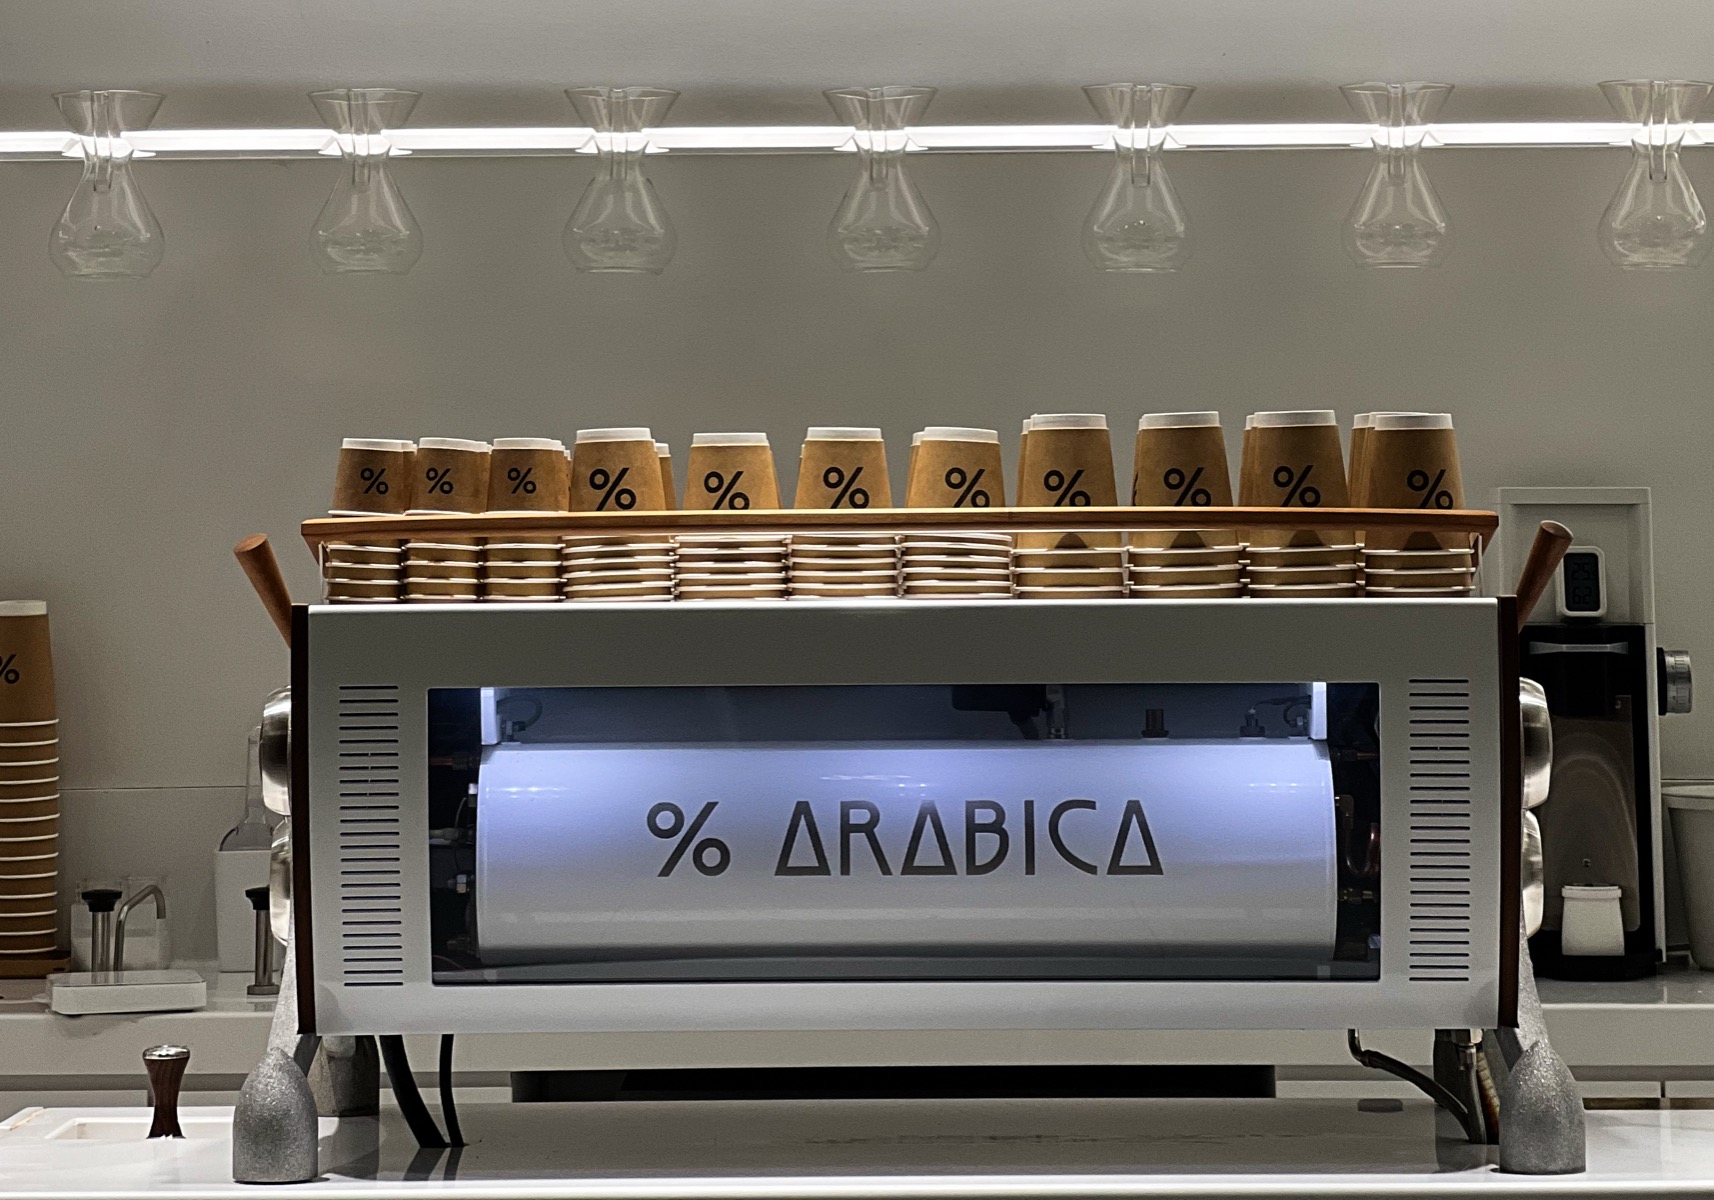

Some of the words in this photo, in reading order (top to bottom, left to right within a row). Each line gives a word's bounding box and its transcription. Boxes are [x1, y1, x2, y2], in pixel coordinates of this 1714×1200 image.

[360, 467, 389, 495] %
[426, 467, 454, 495] %
[507, 467, 537, 495] %
[589, 467, 637, 511] %
[704, 471, 750, 509] %
[823, 466, 870, 508] %
[945, 467, 990, 507] %
[1043, 469, 1091, 506] %
[1164, 467, 1212, 506] %
[1273, 465, 1321, 507] %
[1406, 469, 1453, 509] %
[647, 801, 730, 877] %
[775, 799, 1164, 877] ARABICA
